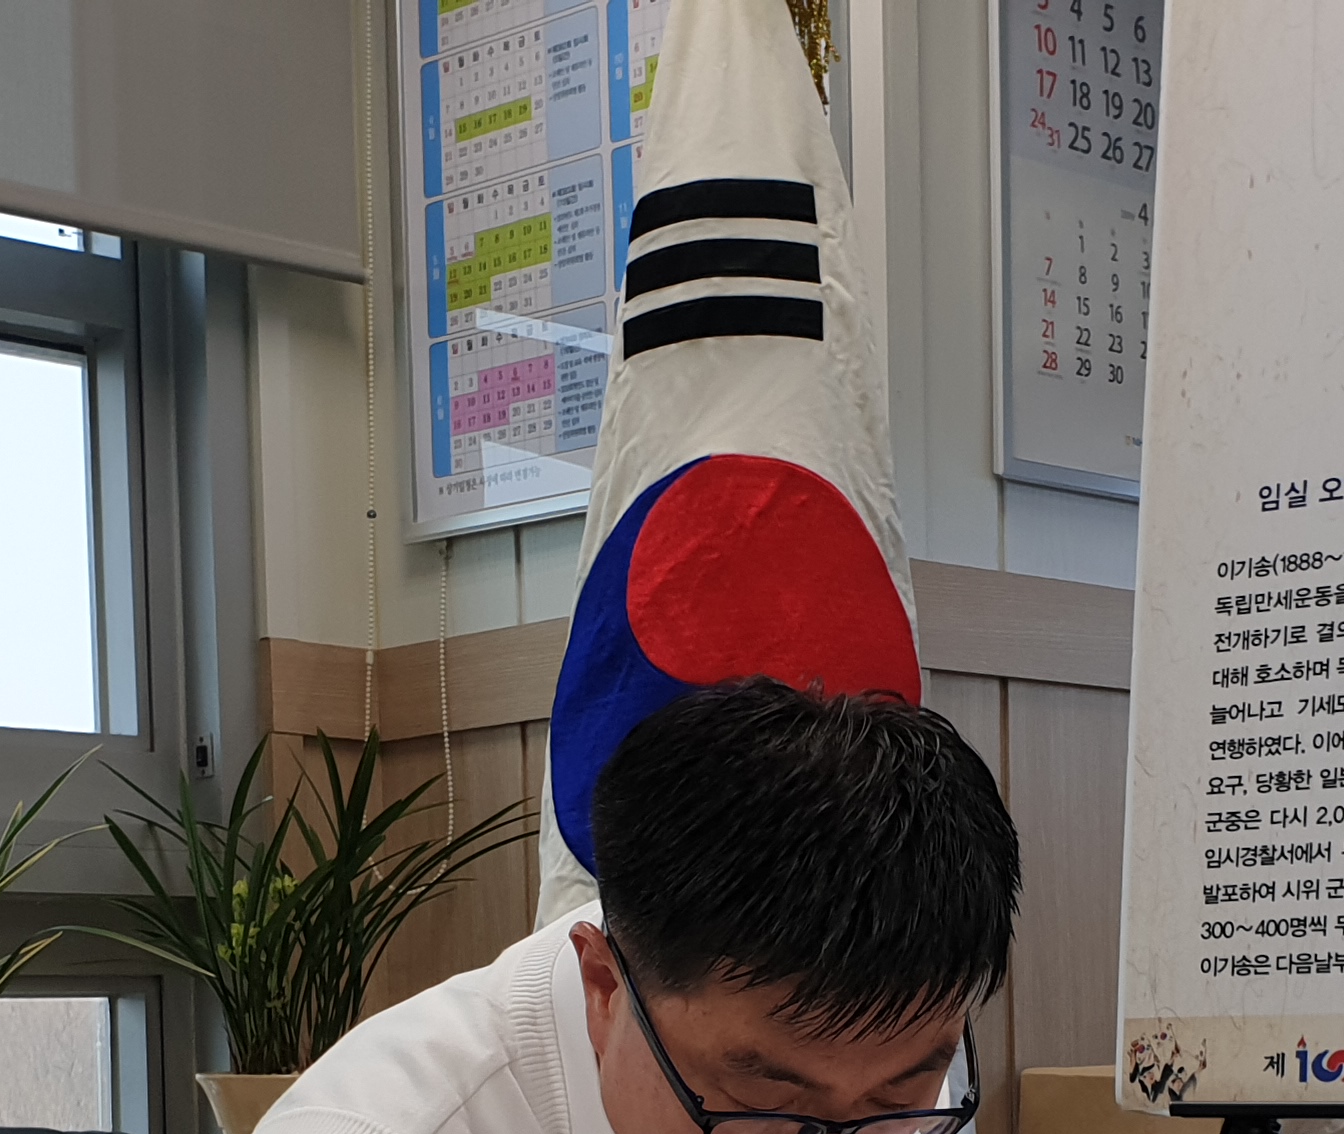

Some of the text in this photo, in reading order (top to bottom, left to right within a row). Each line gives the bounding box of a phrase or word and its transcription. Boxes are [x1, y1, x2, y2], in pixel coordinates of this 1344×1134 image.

[1102, 3, 1147, 43] 5 6
[1034, 23, 1154, 88] 10 11 12 13
[1036, 67, 1156, 131] 17 18 19 20
[1029, 107, 1155, 173] 24 31 25 26 27
[1041, 348, 1125, 385] 28 29 30
[1257, 478, 1308, 513] 임실
[1212, 623, 1309, 654] 전개하기로
[1211, 664, 1249, 689] 대해
[1251, 656, 1331, 685] 호소하며
[1208, 698, 1285, 726] 늘어나고
[1204, 773, 1250, 797] 요구,
[1254, 767, 1314, 794] 당황한
[1203, 808, 1263, 833] 군중은
[1268, 804, 1308, 829] 다시
[1203, 839, 1332, 870] 임시경찰서에서
[1199, 953, 1272, 978] 이기송은
